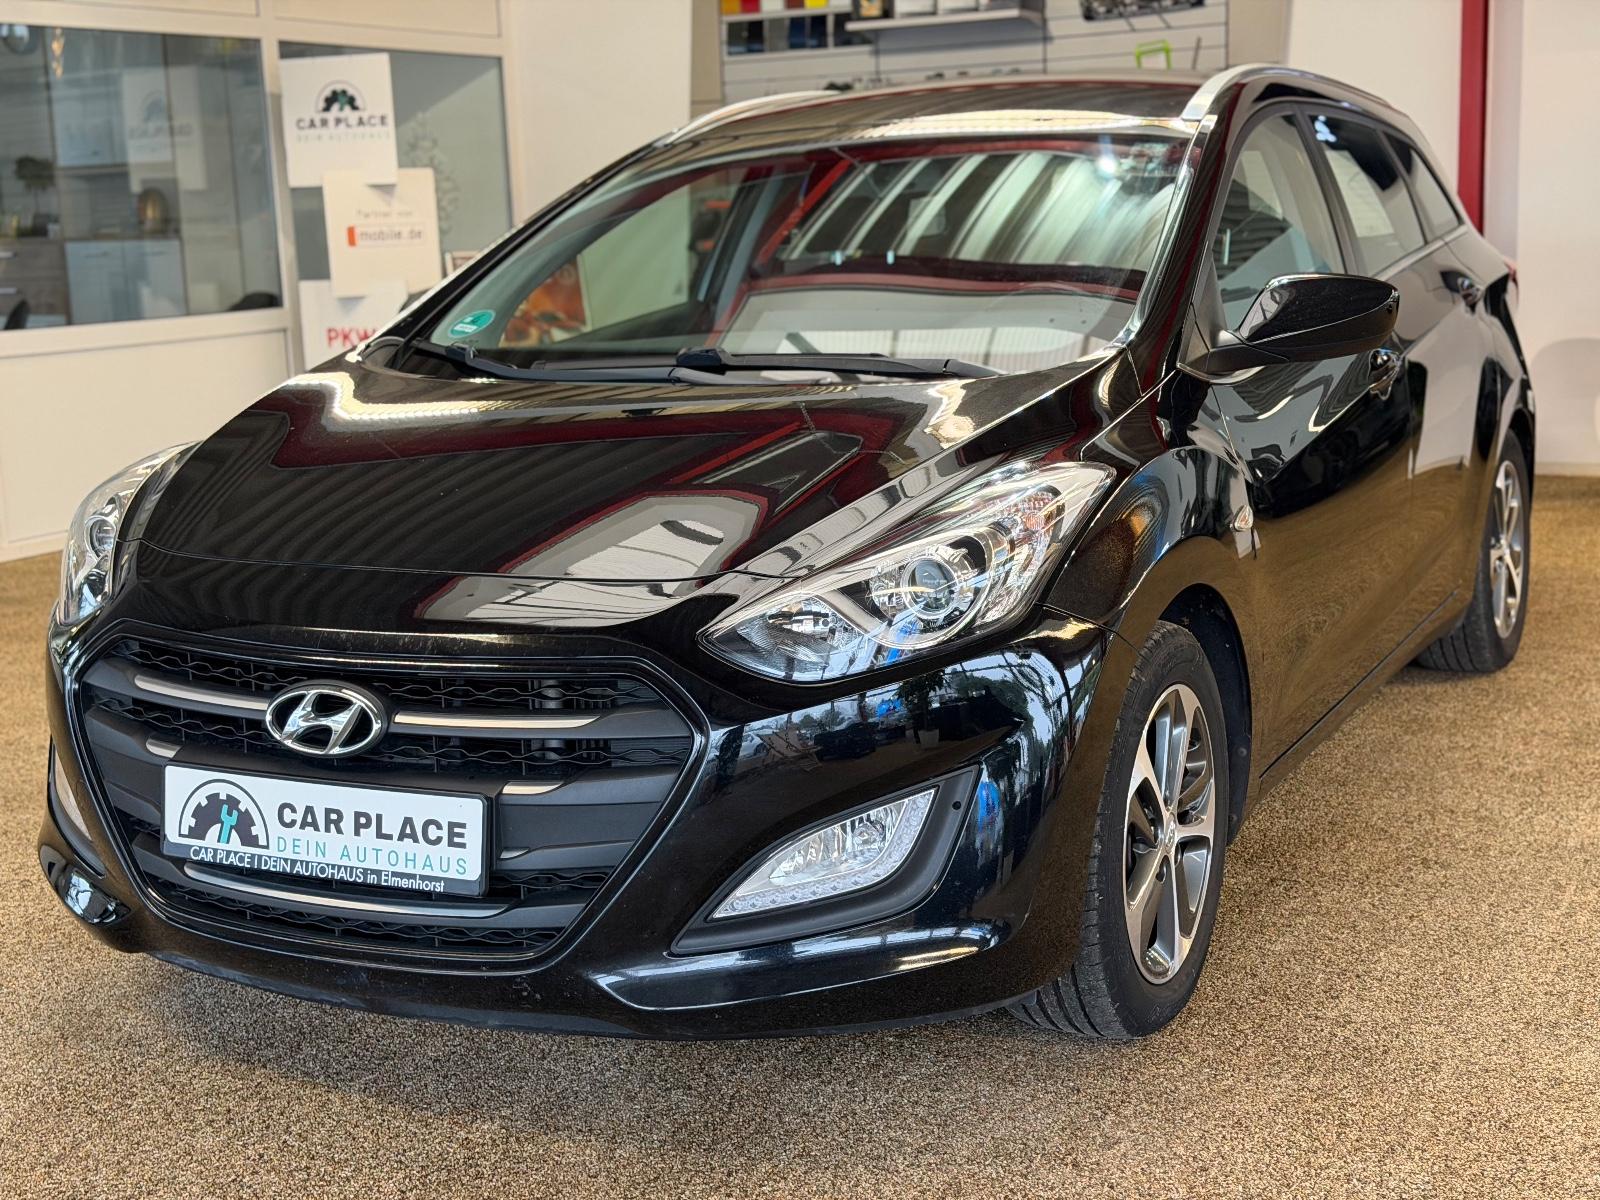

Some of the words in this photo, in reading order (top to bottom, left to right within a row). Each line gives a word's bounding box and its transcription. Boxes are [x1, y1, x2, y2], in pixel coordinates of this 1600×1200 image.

[296, 117, 328, 130] CAR
[334, 115, 388, 128] PLACE
[359, 228, 422, 242] mobile.de
[277, 802, 344, 835] CAR
[353, 811, 468, 849] PLACE
[190, 846, 214, 861] CAR
[216, 849, 251, 867] PLACE
[262, 856, 290, 872] DEIN
[293, 859, 364, 882] AUTOHAUS
[367, 870, 378, 884] in
[381, 872, 445, 893] Elmenhorst
[277, 836, 327, 858] DEIN
[341, 844, 468, 875] AUTOHAUS
